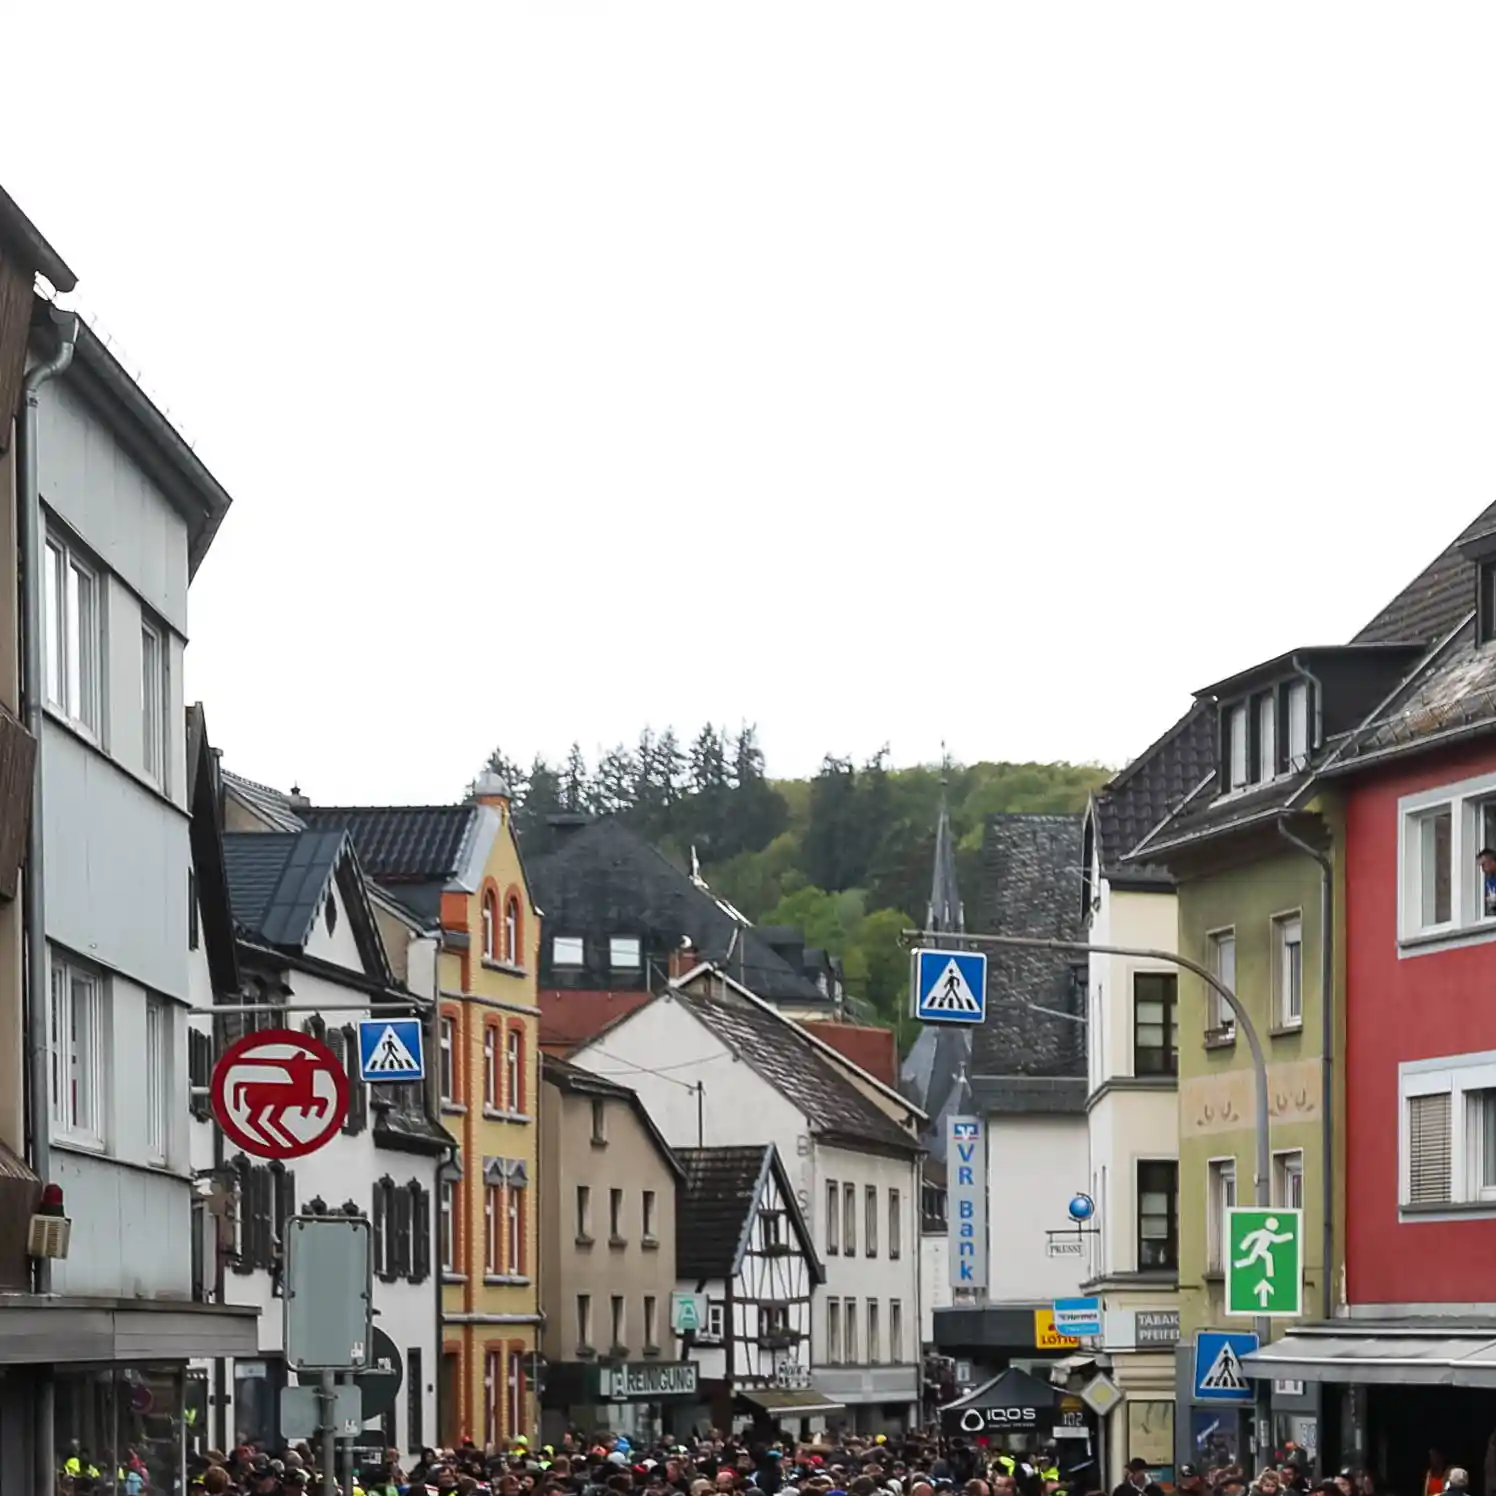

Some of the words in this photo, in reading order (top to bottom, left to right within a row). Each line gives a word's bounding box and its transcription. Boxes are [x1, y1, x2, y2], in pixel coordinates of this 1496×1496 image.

[958, 1143, 974, 1186] VR
[958, 1200, 974, 1281] Bank
[1138, 1314, 1180, 1325] TABAK
[1139, 1329, 1180, 1341] PFEIFE
[627, 1367, 695, 1394] REINIGUNG
[986, 1407, 1036, 1422] IQOS
